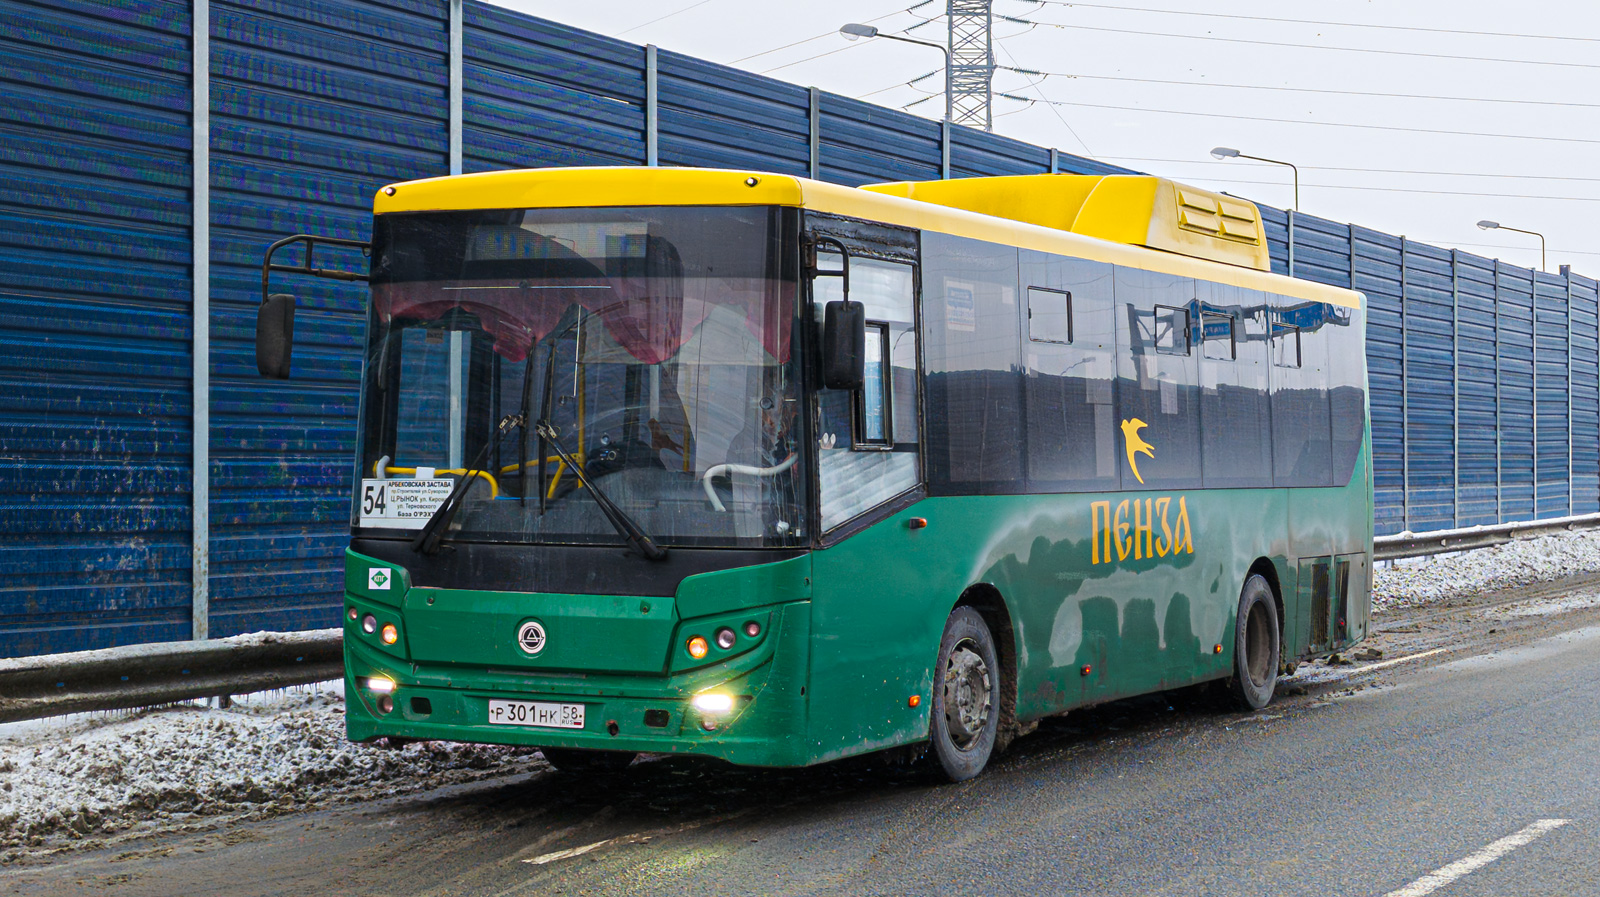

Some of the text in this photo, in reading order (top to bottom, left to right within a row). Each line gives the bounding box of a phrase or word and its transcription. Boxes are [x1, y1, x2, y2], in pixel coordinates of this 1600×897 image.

[363, 485, 386, 515] 54
[1091, 496, 1194, 565] ПЕНЗА
[562, 706, 578, 720] 58
